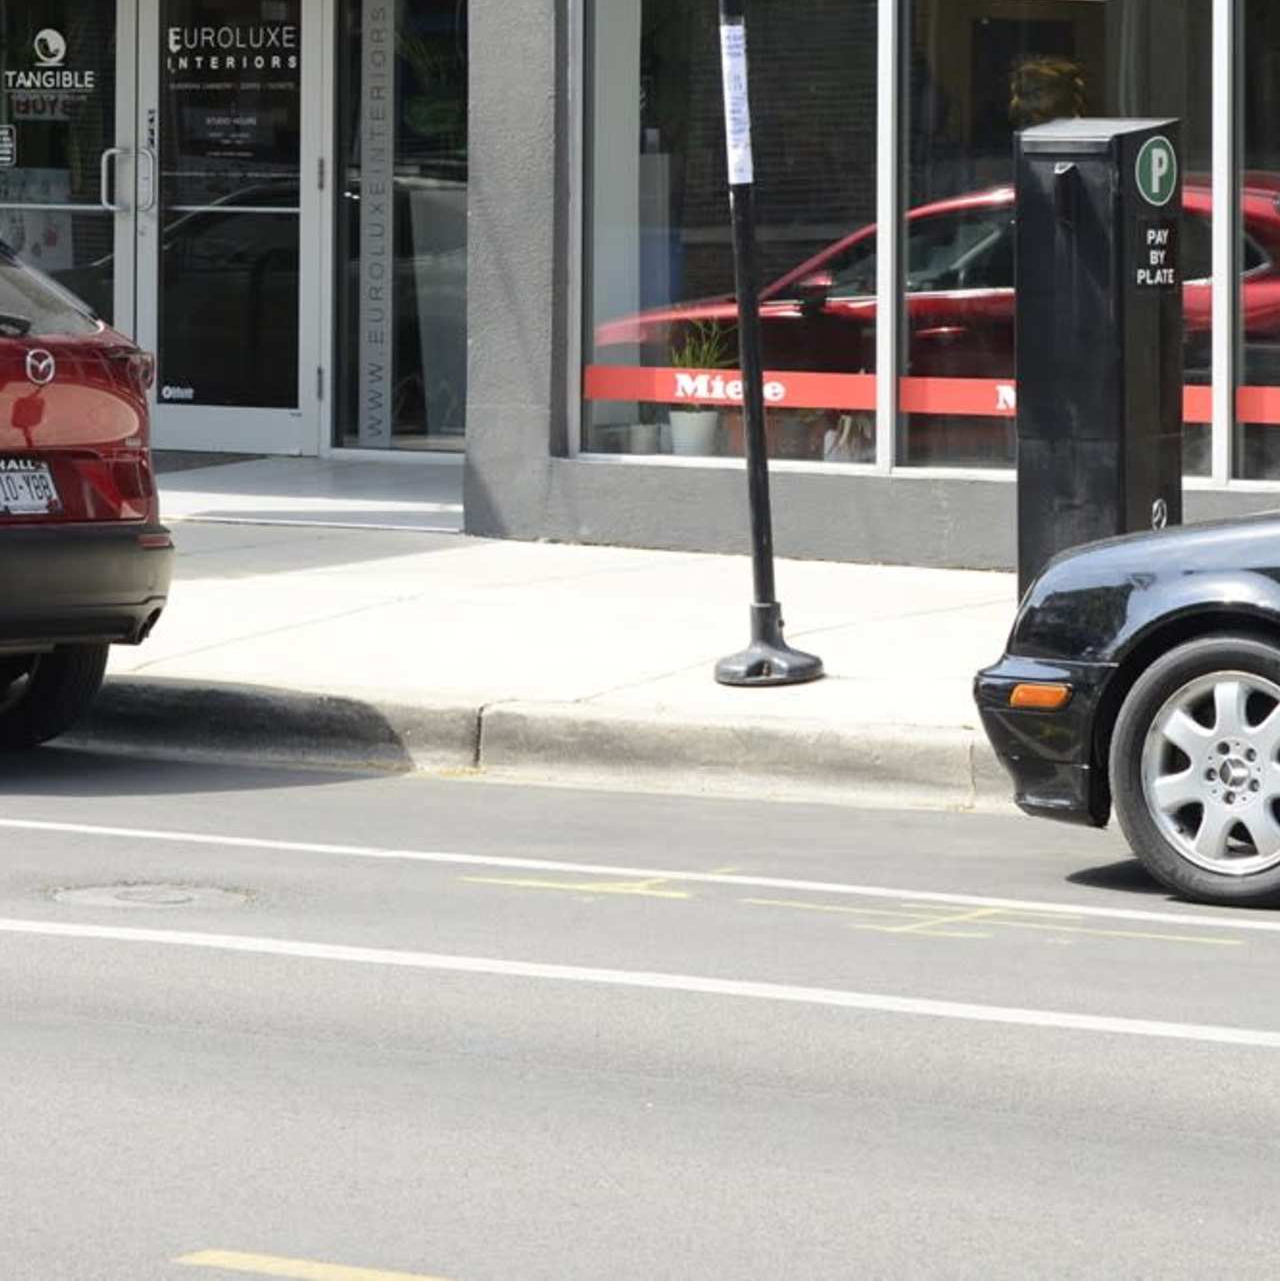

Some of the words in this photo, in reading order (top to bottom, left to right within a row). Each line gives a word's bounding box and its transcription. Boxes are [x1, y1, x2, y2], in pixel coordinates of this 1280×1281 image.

[168, 26, 297, 53] EUROLUXE
[166, 55, 298, 70] INTERIORS
[4, 70, 96, 89] TANGIBLE
[1151, 147, 1169, 193] P
[1146, 229, 1169, 245] PAY
[1150, 250, 1166, 265] BY
[1136, 268, 1174, 285] PLATE
[675, 373, 786, 402] Miee
